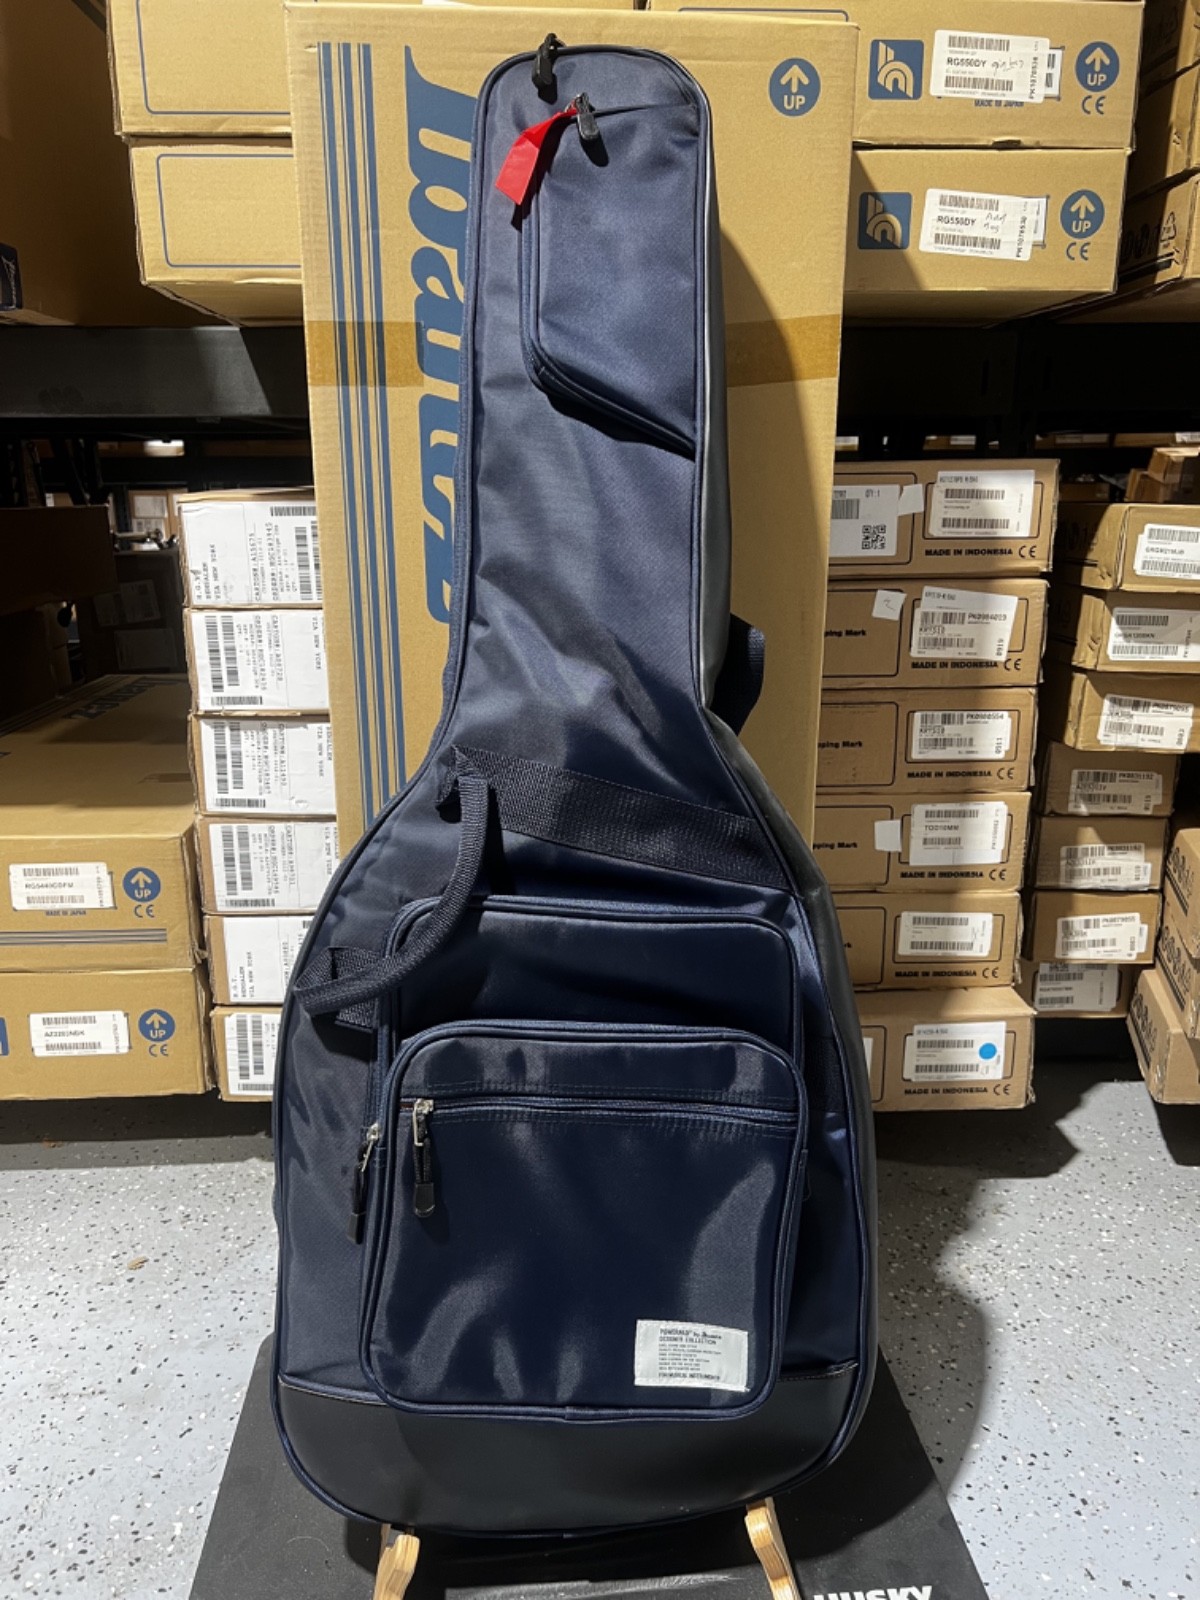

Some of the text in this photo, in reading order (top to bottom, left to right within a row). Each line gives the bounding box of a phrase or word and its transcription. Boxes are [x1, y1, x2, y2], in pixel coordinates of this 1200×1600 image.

[1086, 73, 1107, 87] UP
[783, 94, 806, 110] UP
[1081, 95, 1107, 115] CE
[1071, 220, 1092, 233] UP
[1065, 242, 1091, 261] CE
[925, 549, 950, 557] MADE
[965, 548, 1013, 556] INDONESIA
[1018, 545, 1037, 558] CE
[911, 661, 936, 669] MADE
[951, 660, 998, 668] INDONESIA
[1003, 658, 1022, 671] CE
[842, 740, 863, 748] Mark
[996, 767, 1014, 780] CE
[837, 841, 858, 849] Mark
[901, 871, 925, 879] MADE
[938, 870, 984, 878] INDONESIA
[988, 869, 1006, 881] CE
[134, 889, 152, 899] UP
[134, 904, 155, 918] CE
[982, 967, 999, 979] CE
[150, 1029, 167, 1039] UP
[148, 1043, 169, 1057] CE
[993, 1084, 1011, 1096] CE
[814, 1586, 932, 1600] SKY
